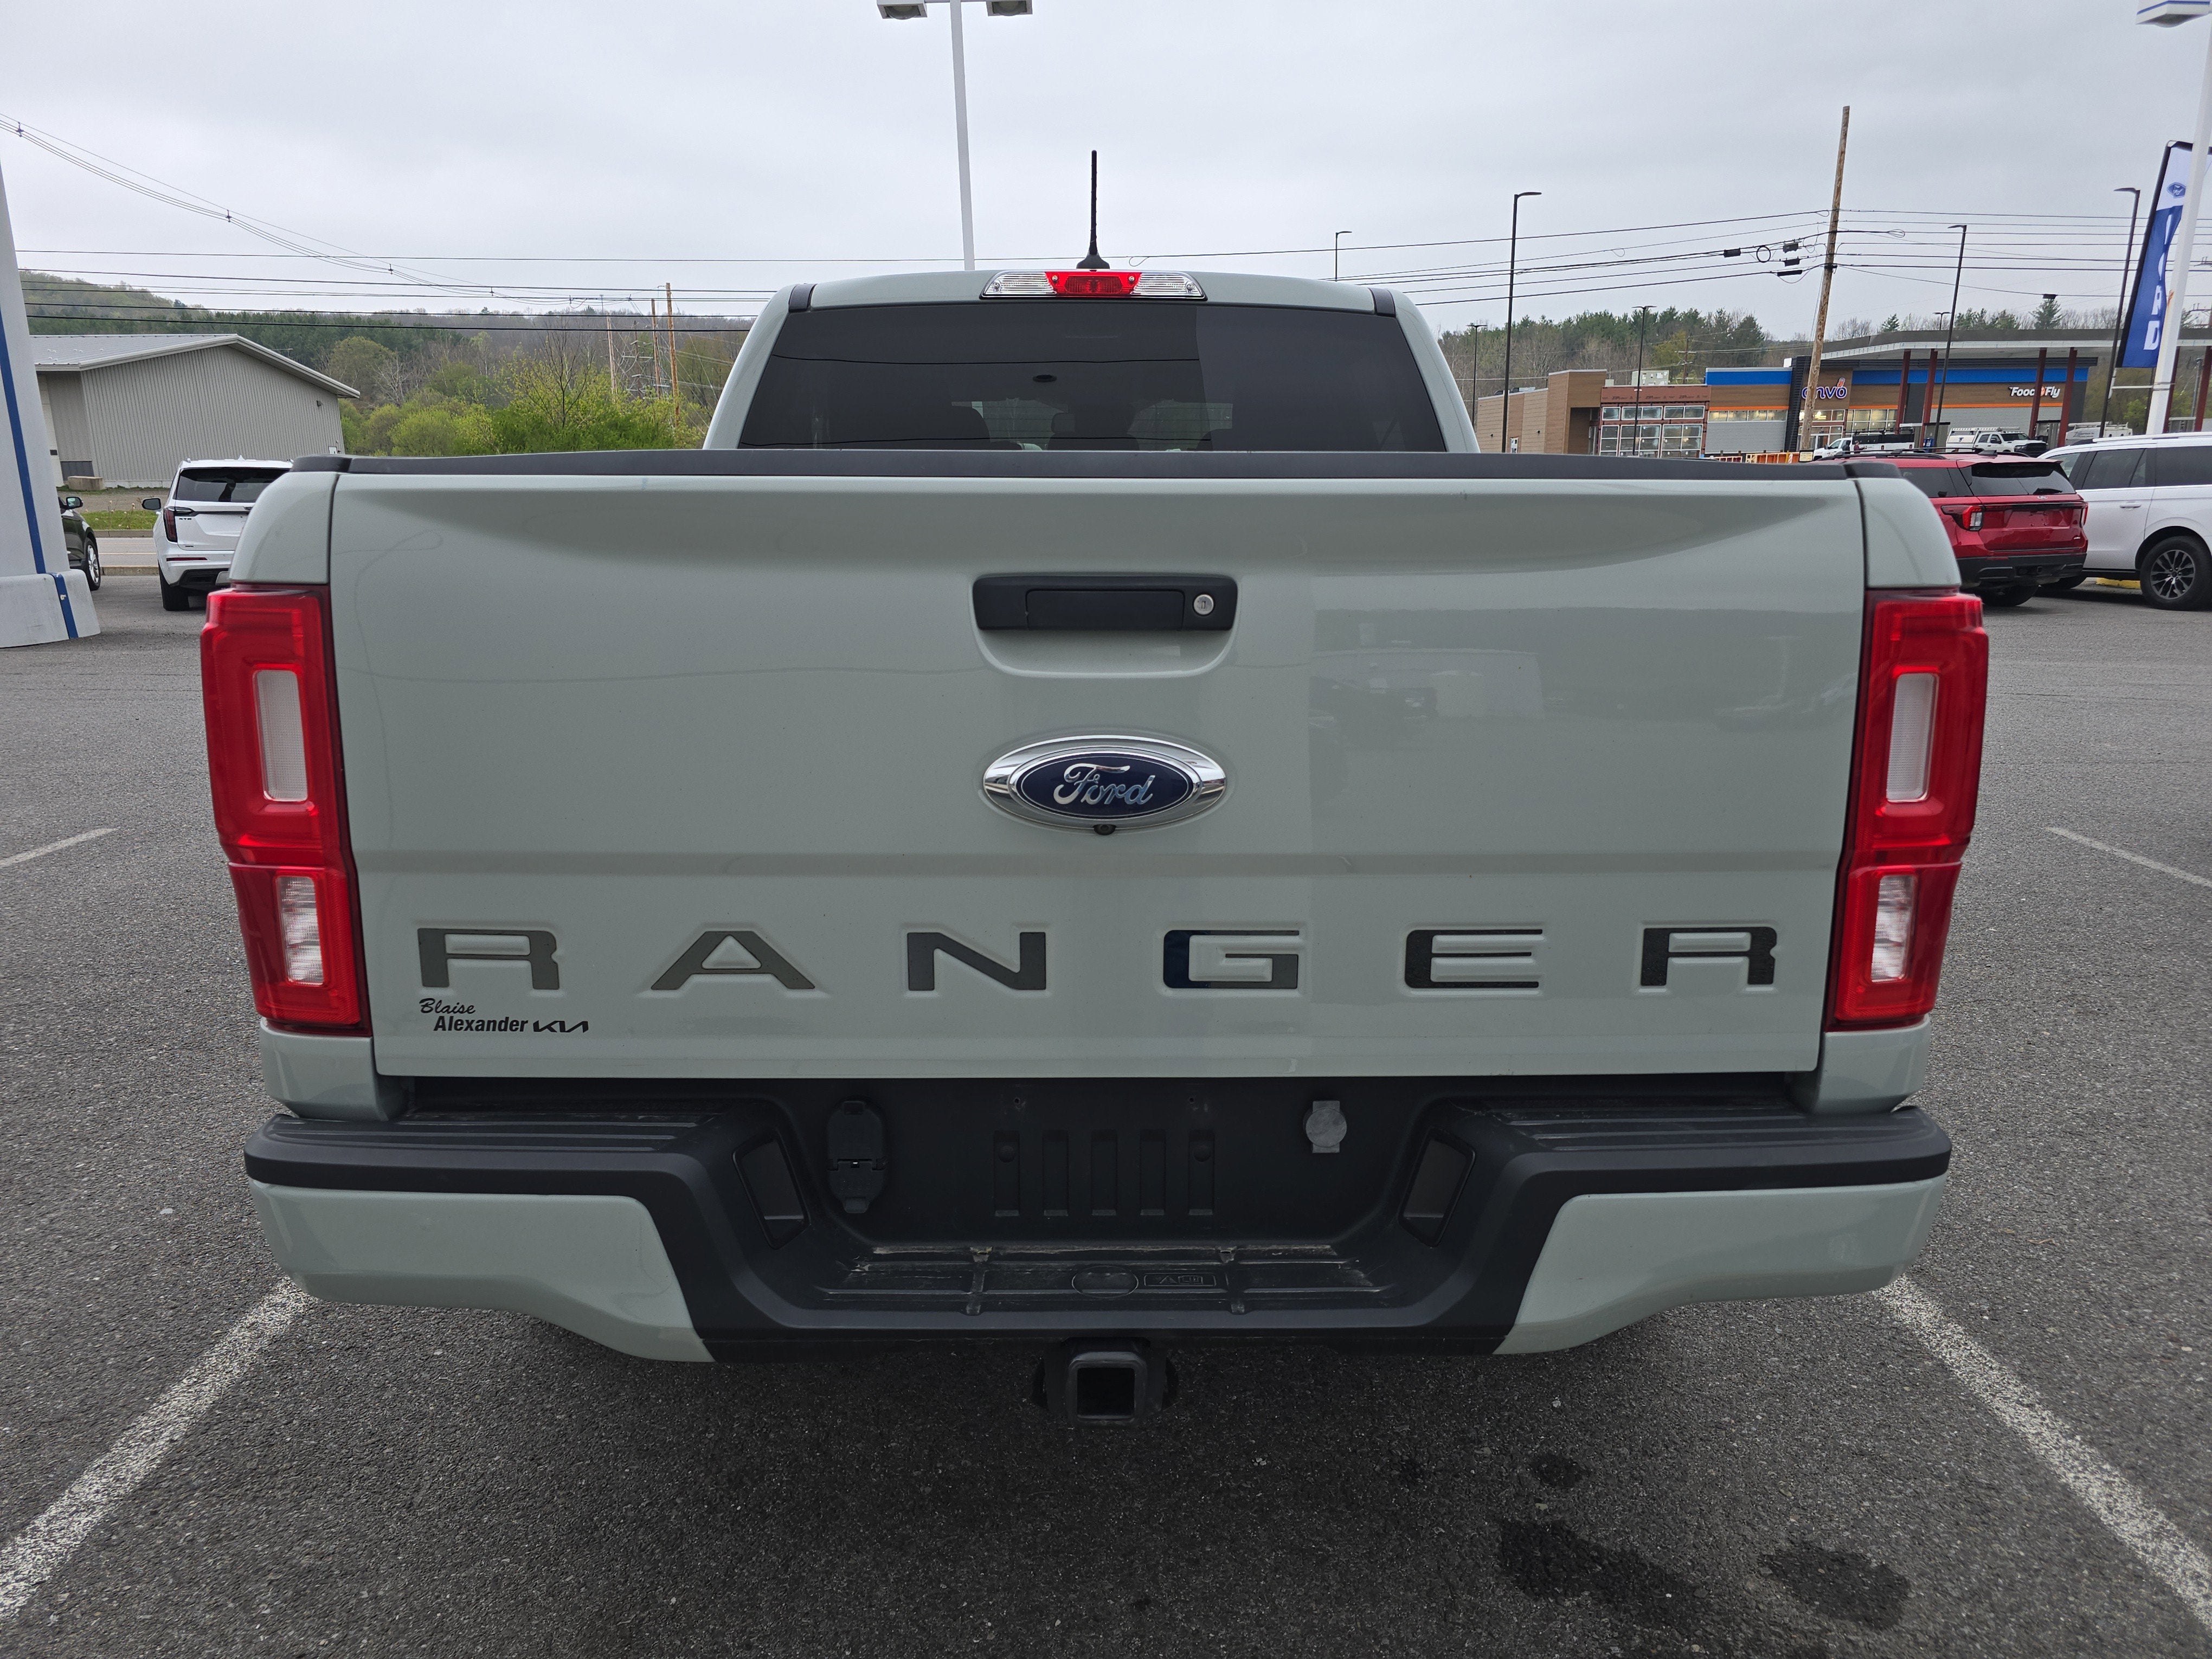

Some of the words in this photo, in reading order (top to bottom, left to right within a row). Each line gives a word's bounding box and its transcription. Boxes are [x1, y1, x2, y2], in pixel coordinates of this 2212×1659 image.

[2143, 214, 2173, 351] RD
[2044, 386, 2060, 398] Fly
[1053, 763, 1155, 805] Ford
[417, 927, 1777, 990] RANGER
[419, 998, 476, 1014] Blaise
[433, 1015, 529, 1032] Alexander
